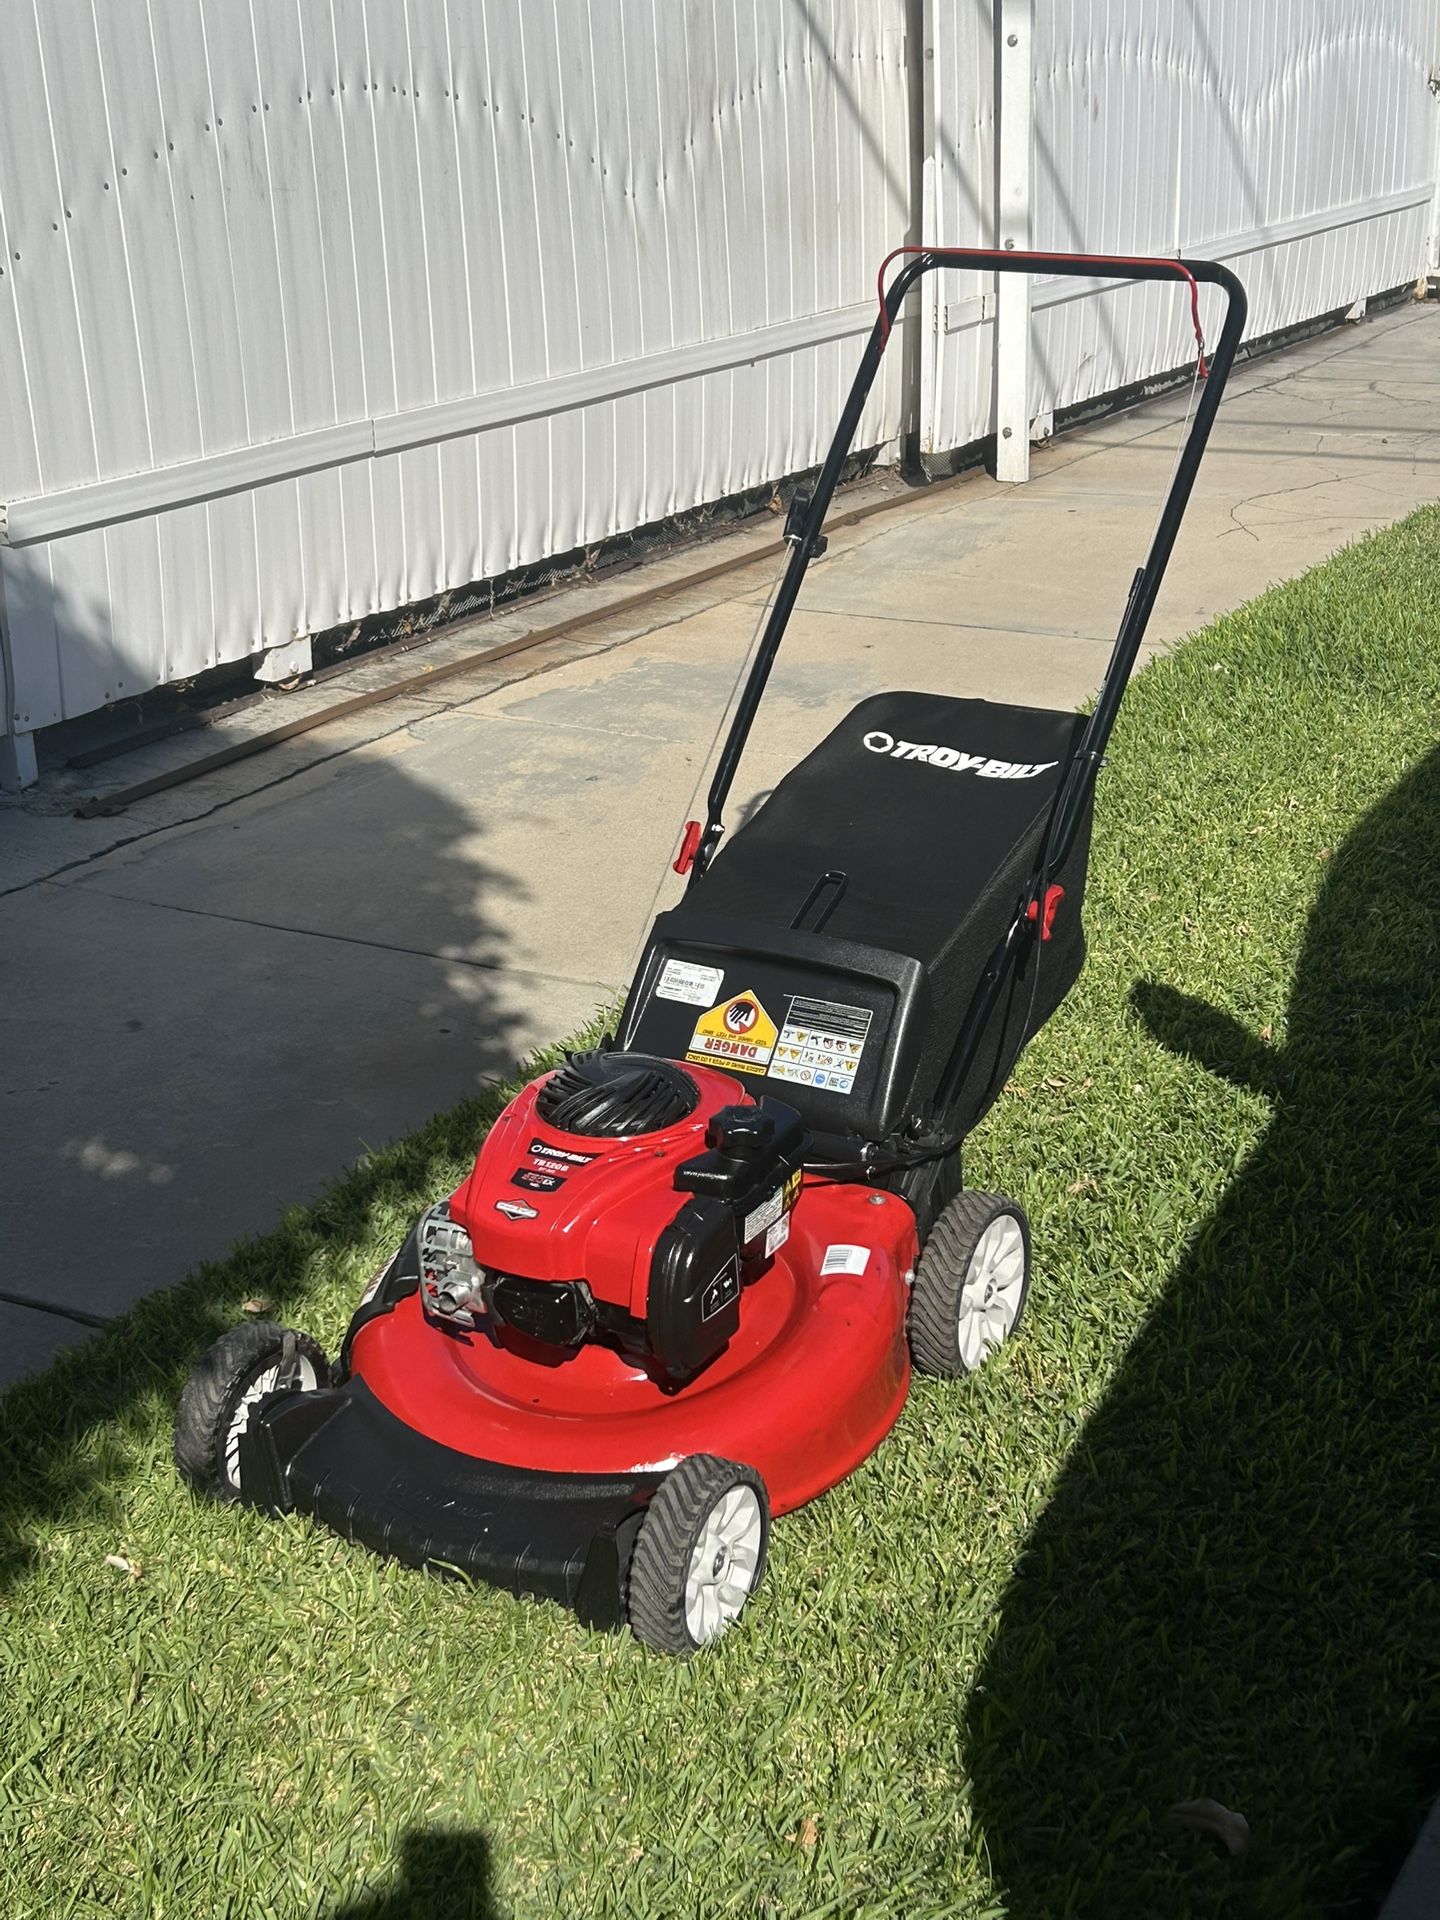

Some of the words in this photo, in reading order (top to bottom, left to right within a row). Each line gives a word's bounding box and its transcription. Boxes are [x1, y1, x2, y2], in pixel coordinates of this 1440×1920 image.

[889, 740, 1059, 779] TROY-BILT
[704, 1037, 758, 1058] DANGER
[541, 1147, 593, 1163] TROY-BILT
